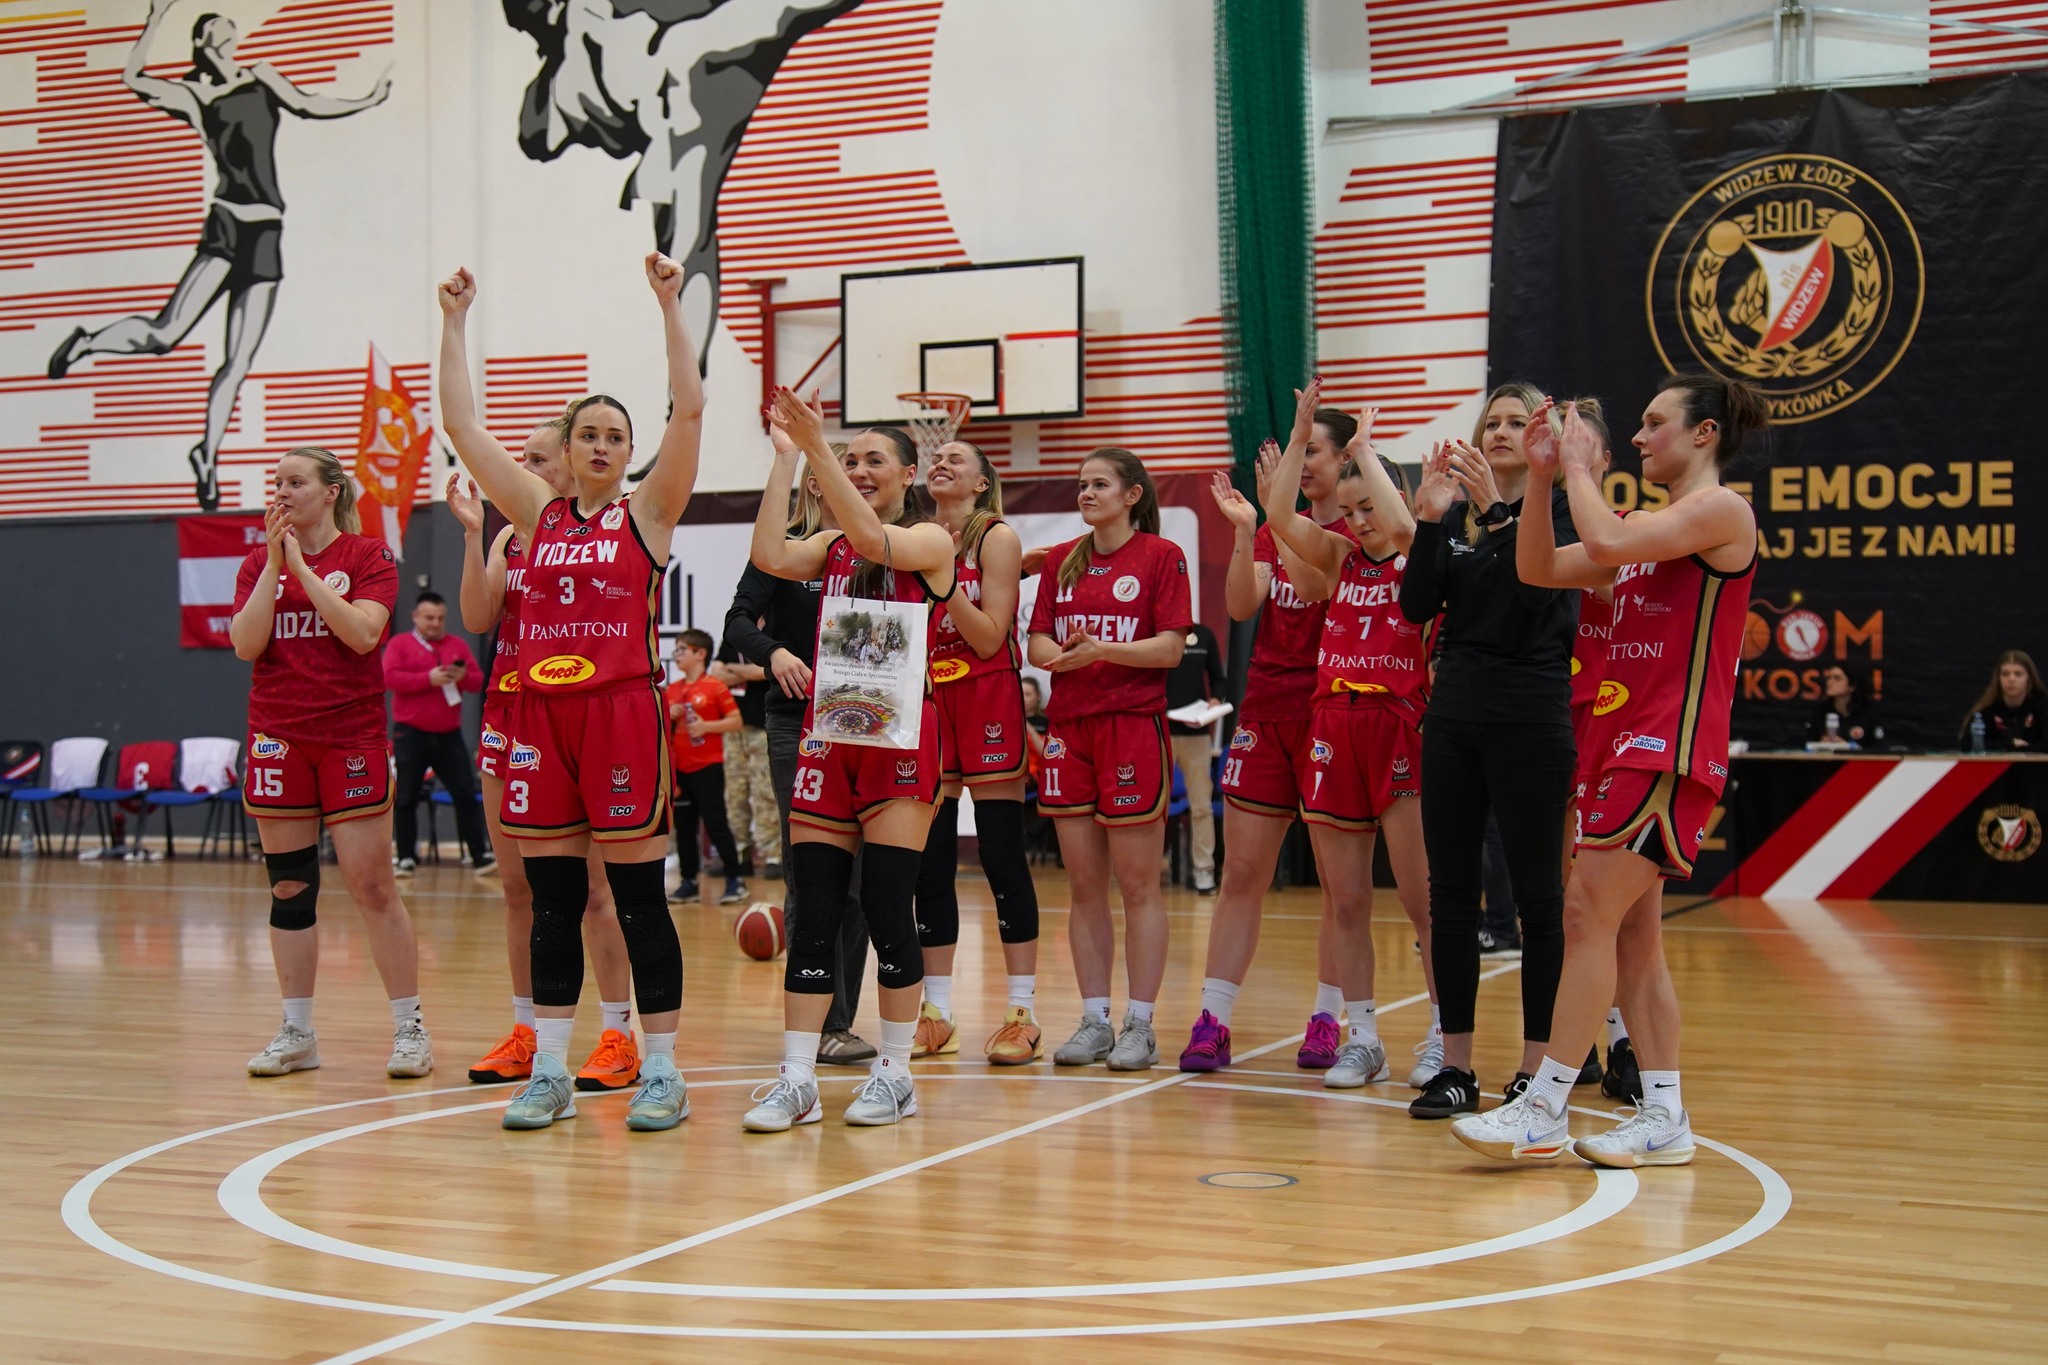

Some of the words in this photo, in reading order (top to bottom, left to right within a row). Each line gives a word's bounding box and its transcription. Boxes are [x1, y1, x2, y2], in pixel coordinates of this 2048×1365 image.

[1714, 164, 1797, 204] WIDZEW
[1801, 162, 1857, 194] ŁÓDŹ
[1755, 199, 1814, 234] 1910
[1780, 266, 1824, 330] WIDZEW
[1767, 378, 1853, 418] YKÓWKA
[1770, 461, 2014, 512] EMOCJE
[1803, 527, 1852, 558] JE
[1862, 526, 1887, 557] Z
[1899, 523, 2016, 556] NAMI!
[559, 577, 575, 604] 3
[275, 611, 329, 639] IDZE
[529, 622, 628, 640] PANATTONI
[1359, 616, 1372, 640] 7
[1328, 654, 1414, 671] PANATTONI
[1608, 642, 1664, 660] TTONI
[258, 743, 280, 754] LOTTO
[511, 751, 535, 763] LOTTO
[982, 753, 1007, 763] TICO
[253, 767, 283, 797] 15
[793, 767, 824, 801] 43
[1045, 768, 1061, 796] 11
[1222, 758, 1243, 787] 31
[345, 786, 373, 798] TICO
[509, 780, 529, 813] 3
[1114, 795, 1141, 806] TICO
[609, 805, 636, 816] TICO
